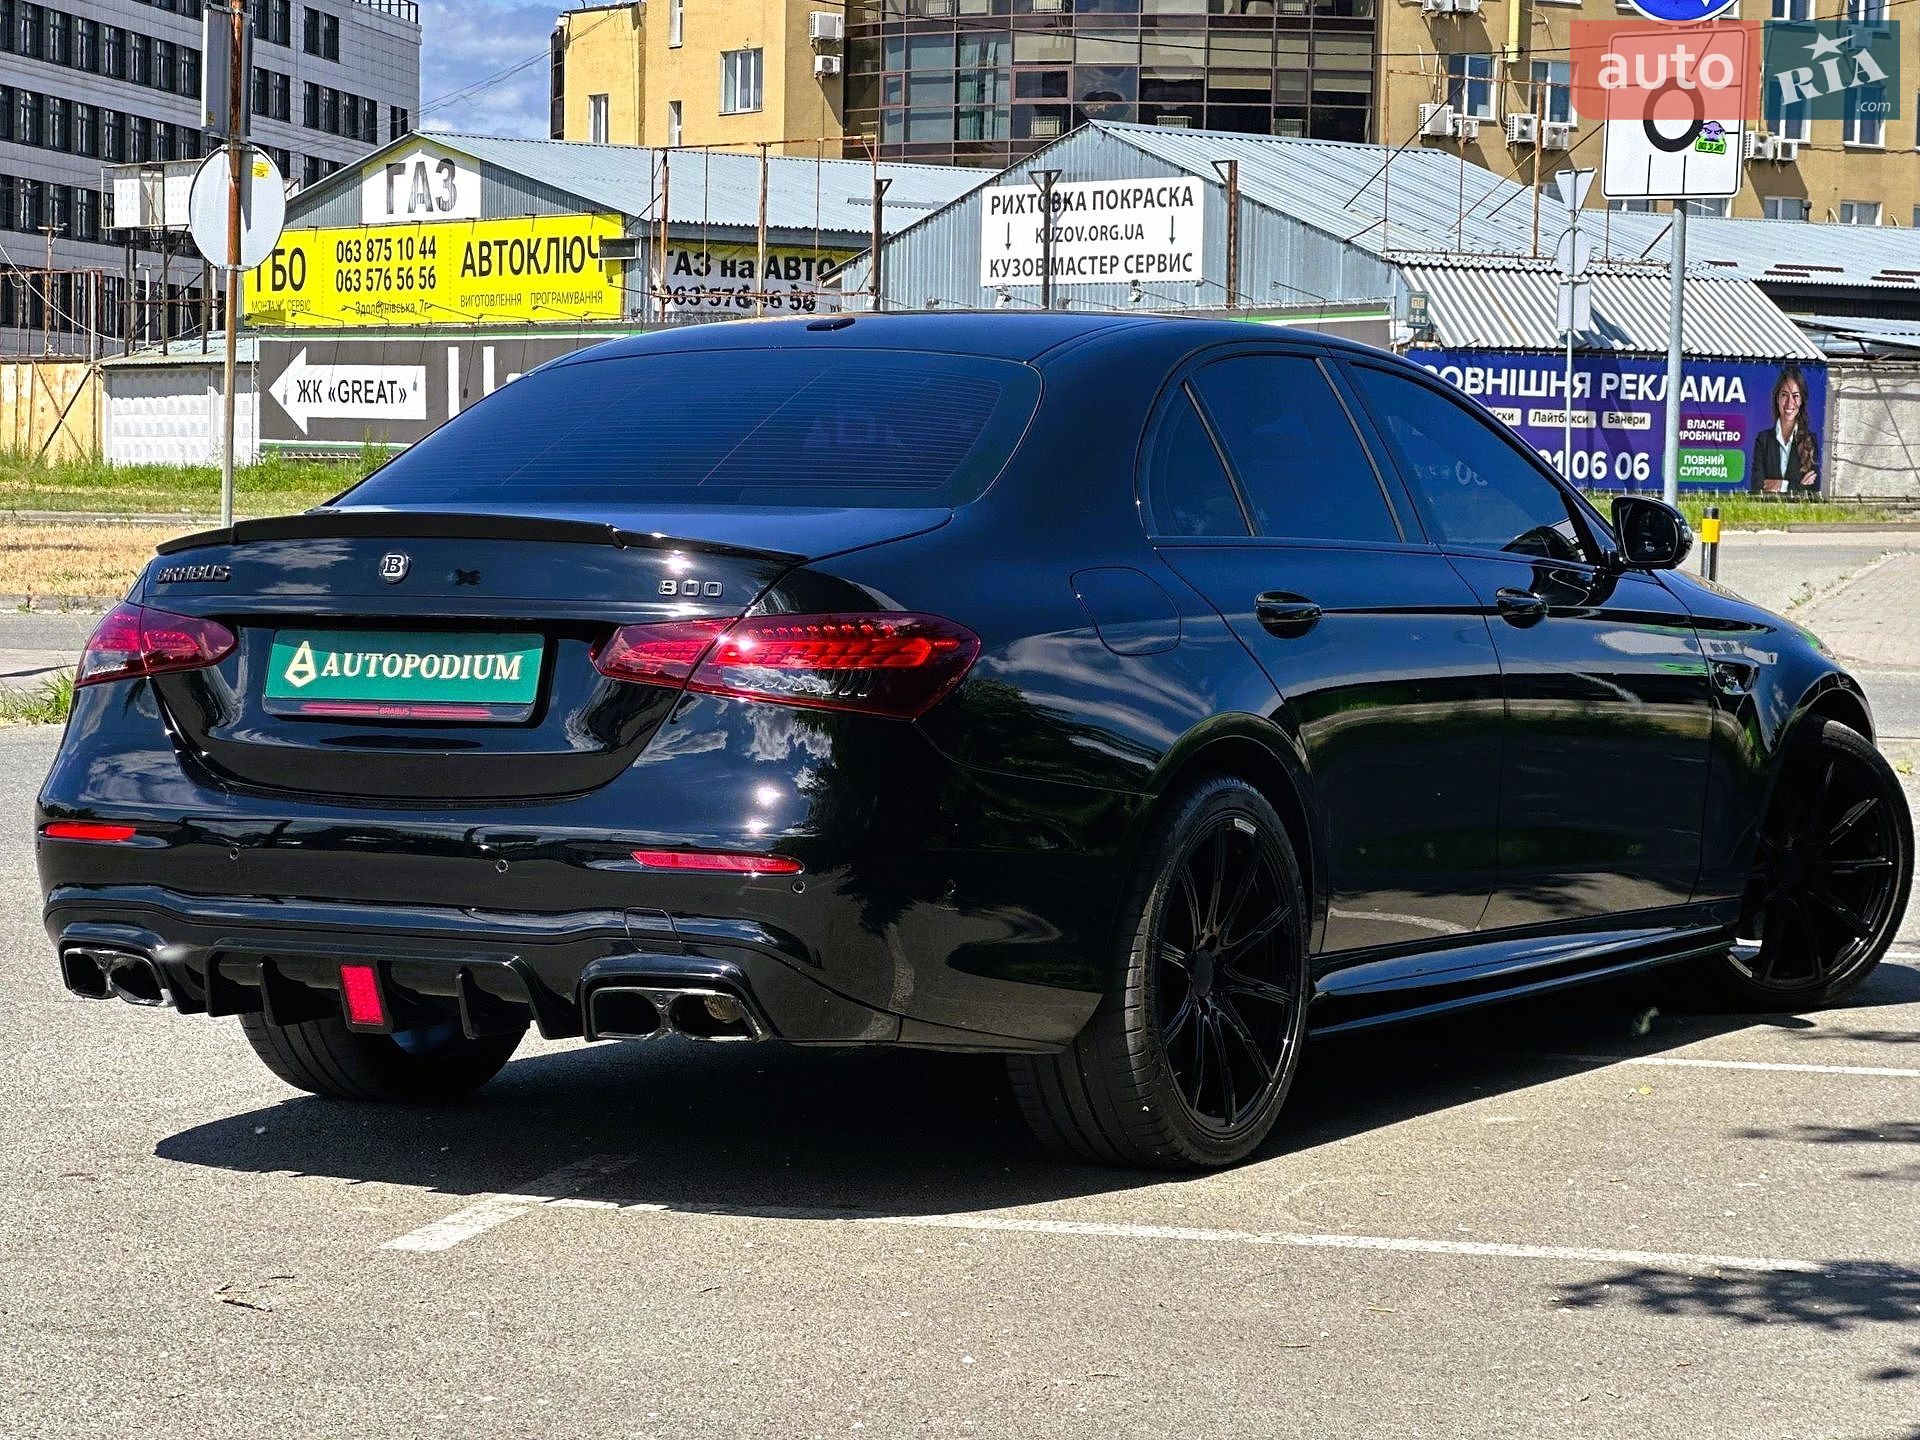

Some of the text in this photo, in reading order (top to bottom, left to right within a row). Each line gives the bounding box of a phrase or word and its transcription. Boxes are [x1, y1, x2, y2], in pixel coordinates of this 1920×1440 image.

[386, 158, 458, 214] ГАЗ
[1092, 186, 1194, 211] ПОКРАСКА
[336, 235, 437, 263] 063 875 10 44
[460, 234, 603, 278] АВТОКЛЮЧ
[720, 258, 755, 279] на
[990, 252, 1193, 278] КУЗОВ МАСТЕР СЕРВИС
[336, 265, 437, 292] 063 576 56 56
[460, 290, 603, 307] ВИГОТОВЛЕННЯ ПРОГРАМУВАННЯ
[296, 379, 407, 404] ЖК «GREAT»
[1423, 364, 1592, 398] ОВНІШНЯ
[1532, 411, 1589, 424] Лайтбкси
[1607, 413, 1646, 427] Банери
[1686, 419, 1726, 430] ВЛАСНЕ
[1571, 450, 1608, 480] 06
[1614, 451, 1650, 480] 06
[1680, 466, 1728, 478] СУПРОВІД
[1683, 454, 1725, 465] ПОВНИЙ
[383, 555, 404, 577] B
[658, 580, 724, 597] 800
[321, 651, 521, 682] AUTOPODIUM
